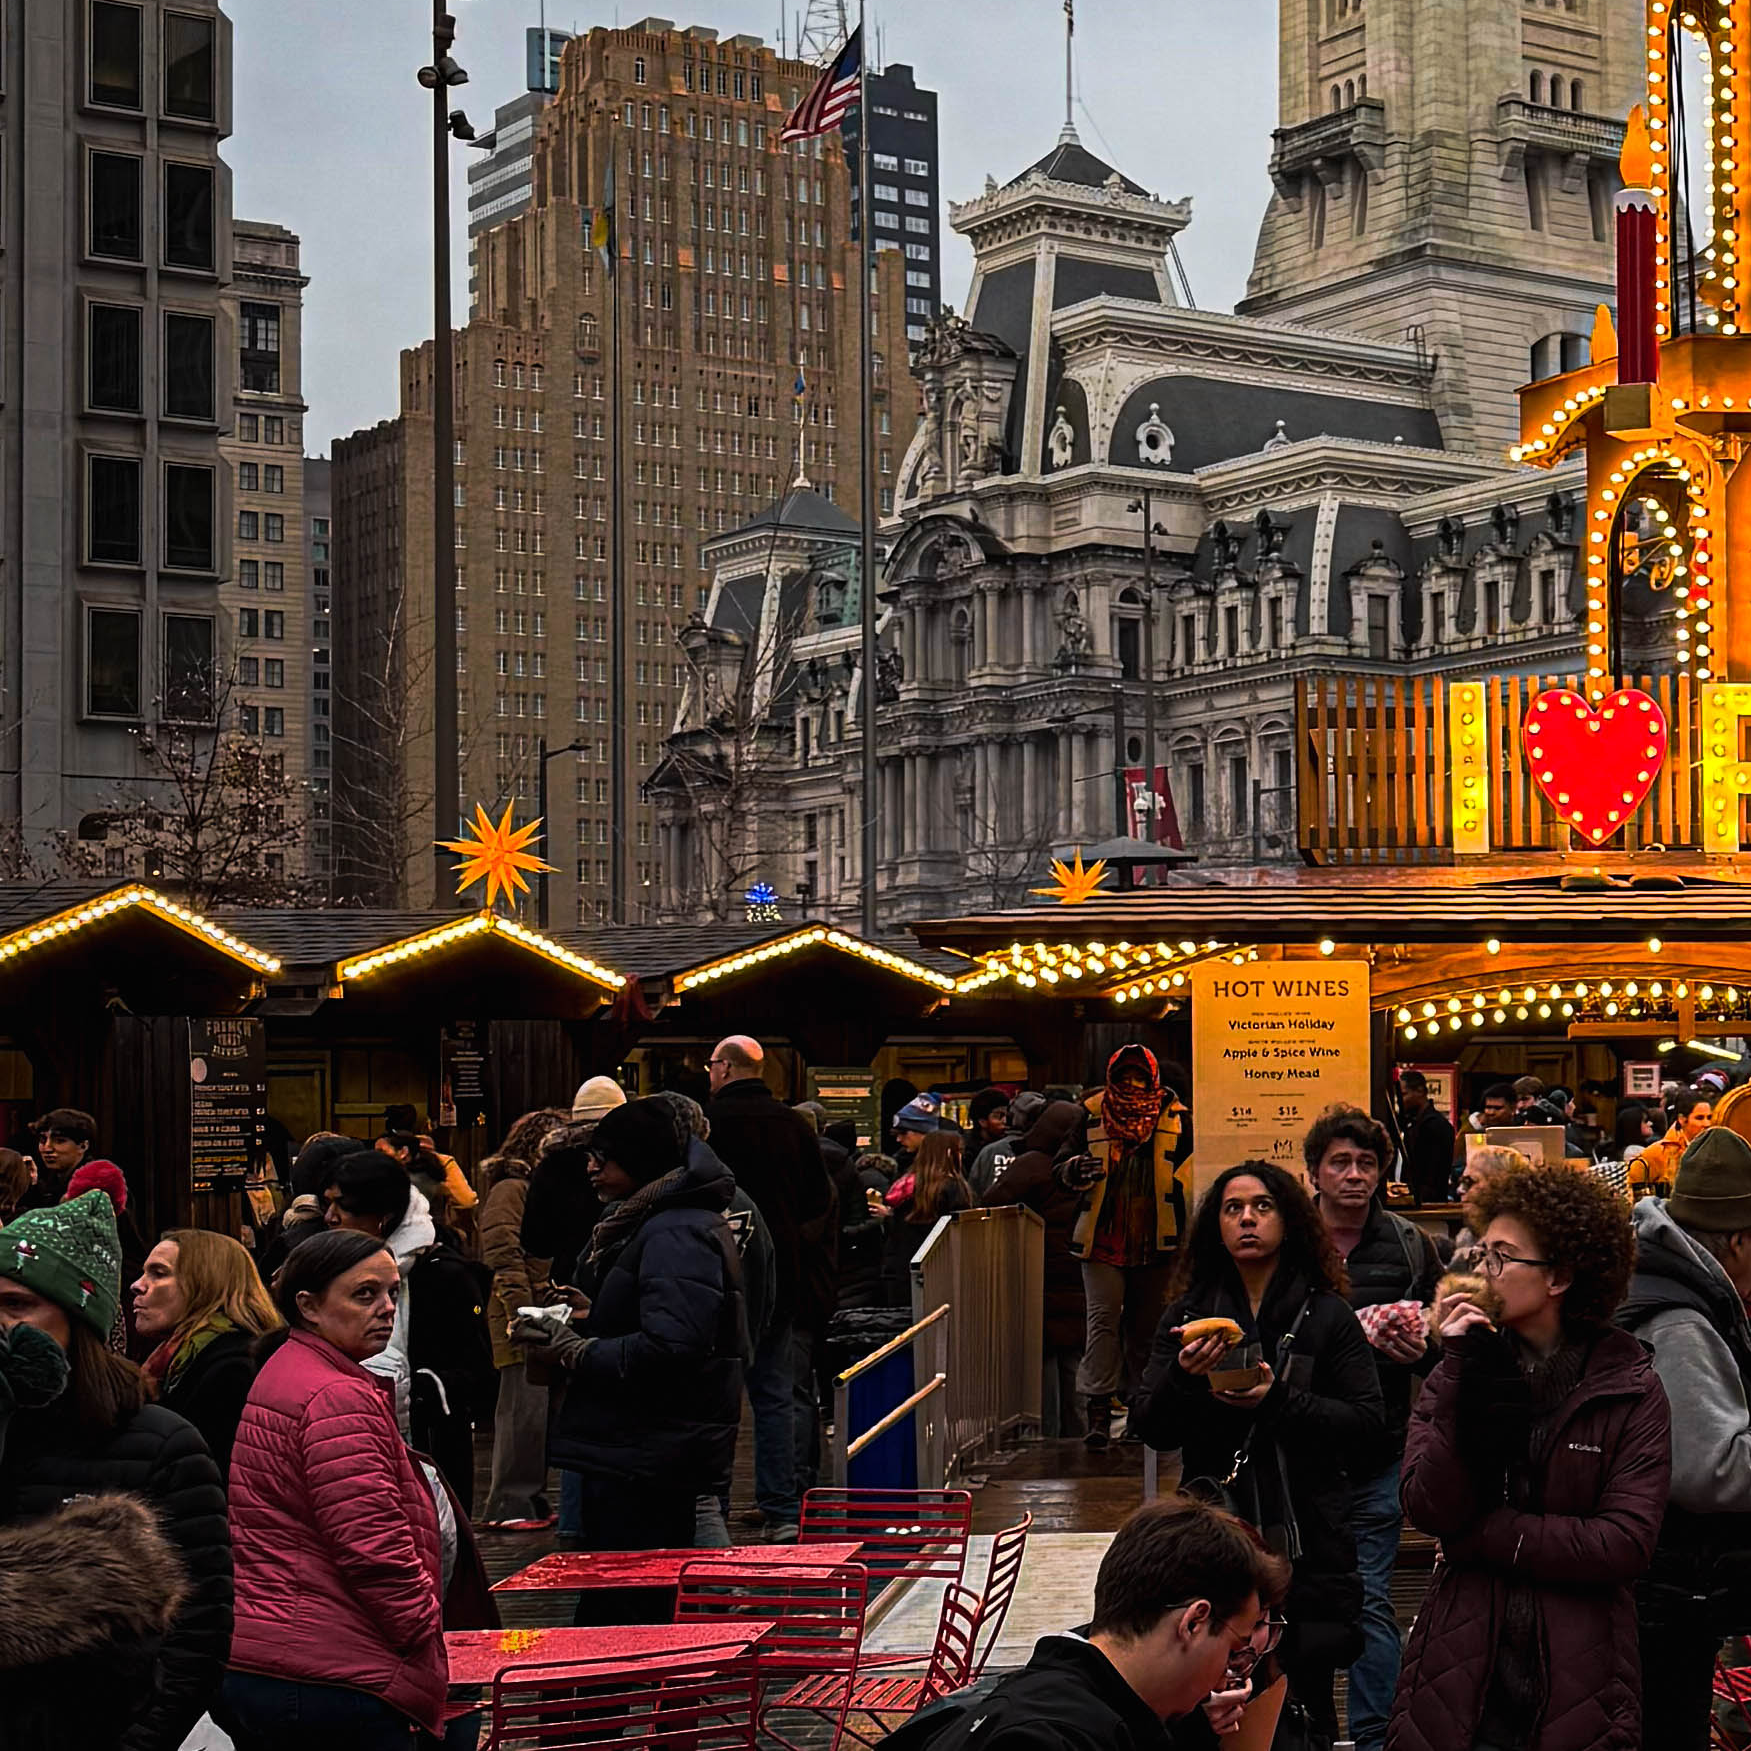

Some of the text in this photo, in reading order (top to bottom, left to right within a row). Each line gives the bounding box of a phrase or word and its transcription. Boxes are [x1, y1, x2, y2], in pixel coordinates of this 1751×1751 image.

[1449, 682, 1491, 854] I
[1213, 980, 1349, 997] HOT WINES
[1228, 1019, 1335, 1031] Victorian Holiday
[1223, 1048, 1258, 1060] Apple
[1273, 1047, 1306, 1059] Spice
[1309, 1046, 1340, 1057] Wine
[1244, 1068, 1320, 1080] Honey Mead
